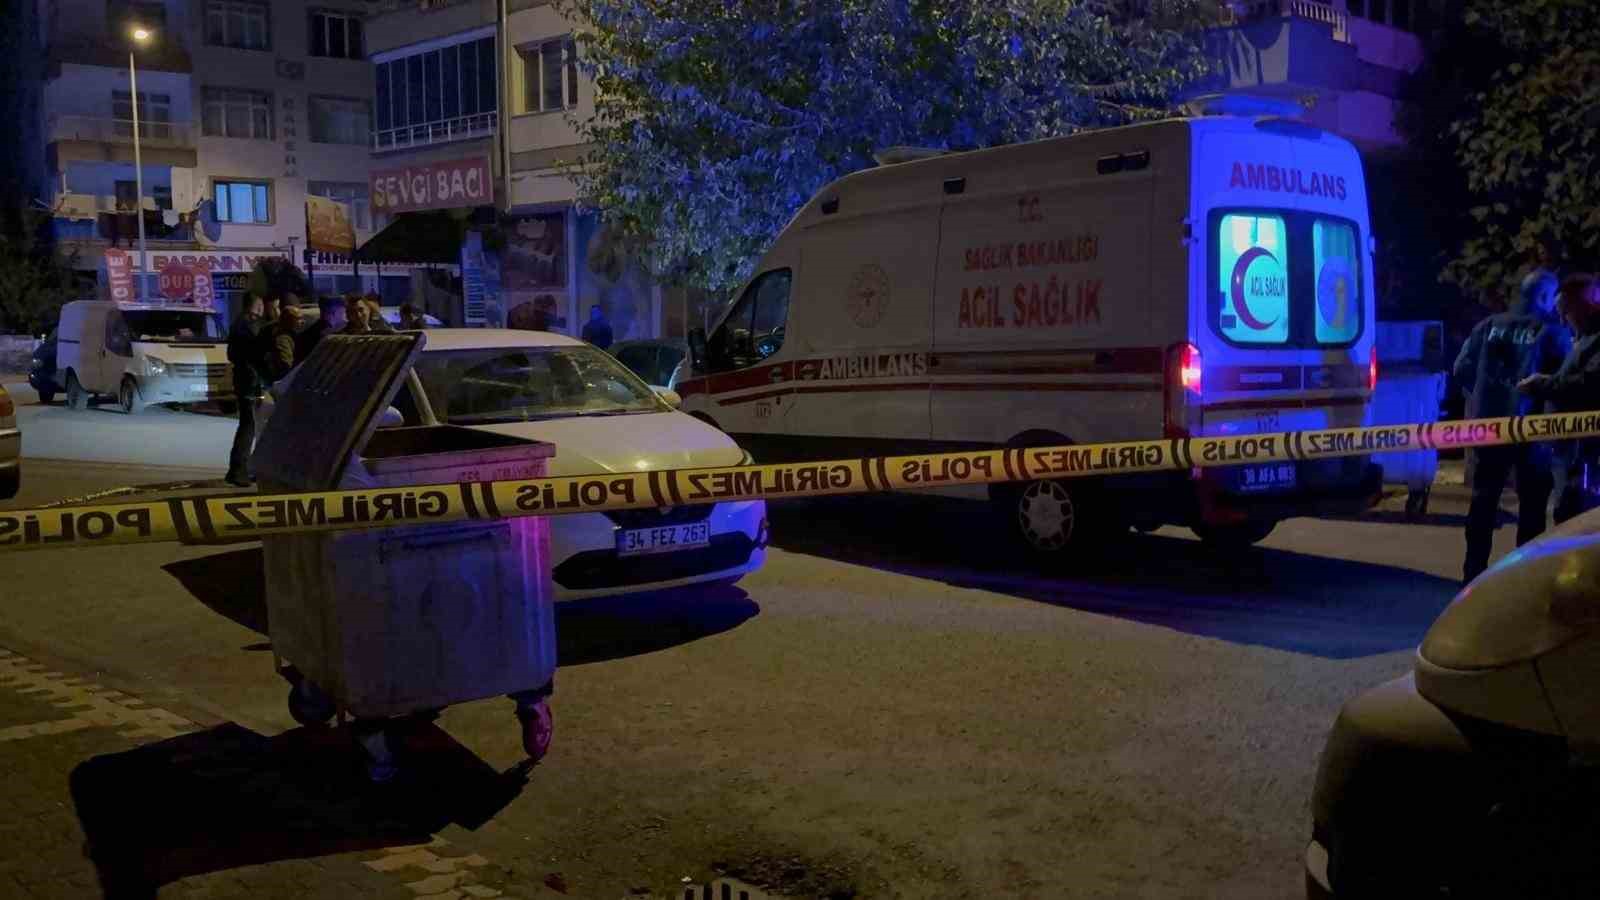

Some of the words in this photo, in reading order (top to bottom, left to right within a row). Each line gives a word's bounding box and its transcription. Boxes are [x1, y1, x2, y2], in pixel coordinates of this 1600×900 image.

[1229, 162, 1347, 200] AMBULANS
[1013, 273, 1103, 327] SAĞLIK
[819, 353, 928, 379] AMBULANS
[627, 531, 644, 549] 34
[651, 527, 676, 546] FEZ
